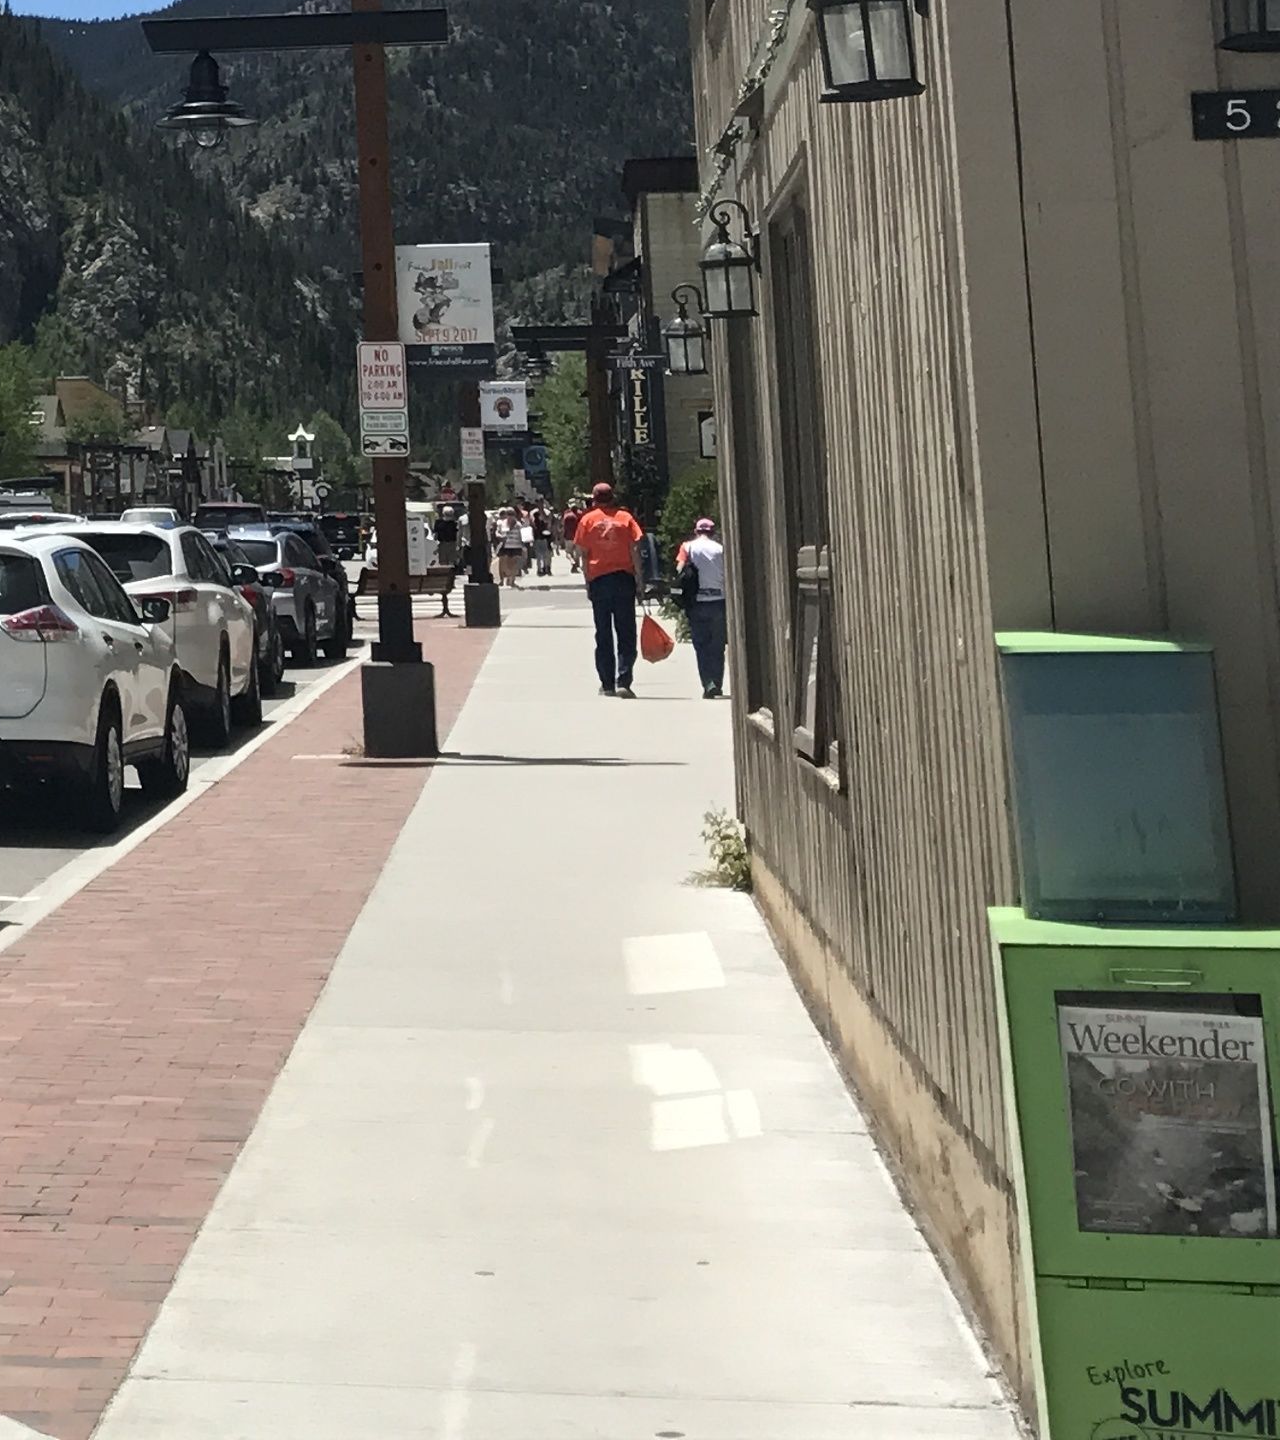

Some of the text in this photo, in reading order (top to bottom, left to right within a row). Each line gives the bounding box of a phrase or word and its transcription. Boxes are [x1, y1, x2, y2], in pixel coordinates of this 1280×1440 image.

[374, 349, 389, 362] NO
[363, 364, 402, 377] PARKING
[1067, 1022, 1255, 1062] Weekender
[1098, 1077, 1216, 1100] GO WITH
[1085, 1359, 1171, 1390] Explore
[1120, 1386, 1280, 1436] SUMMI
